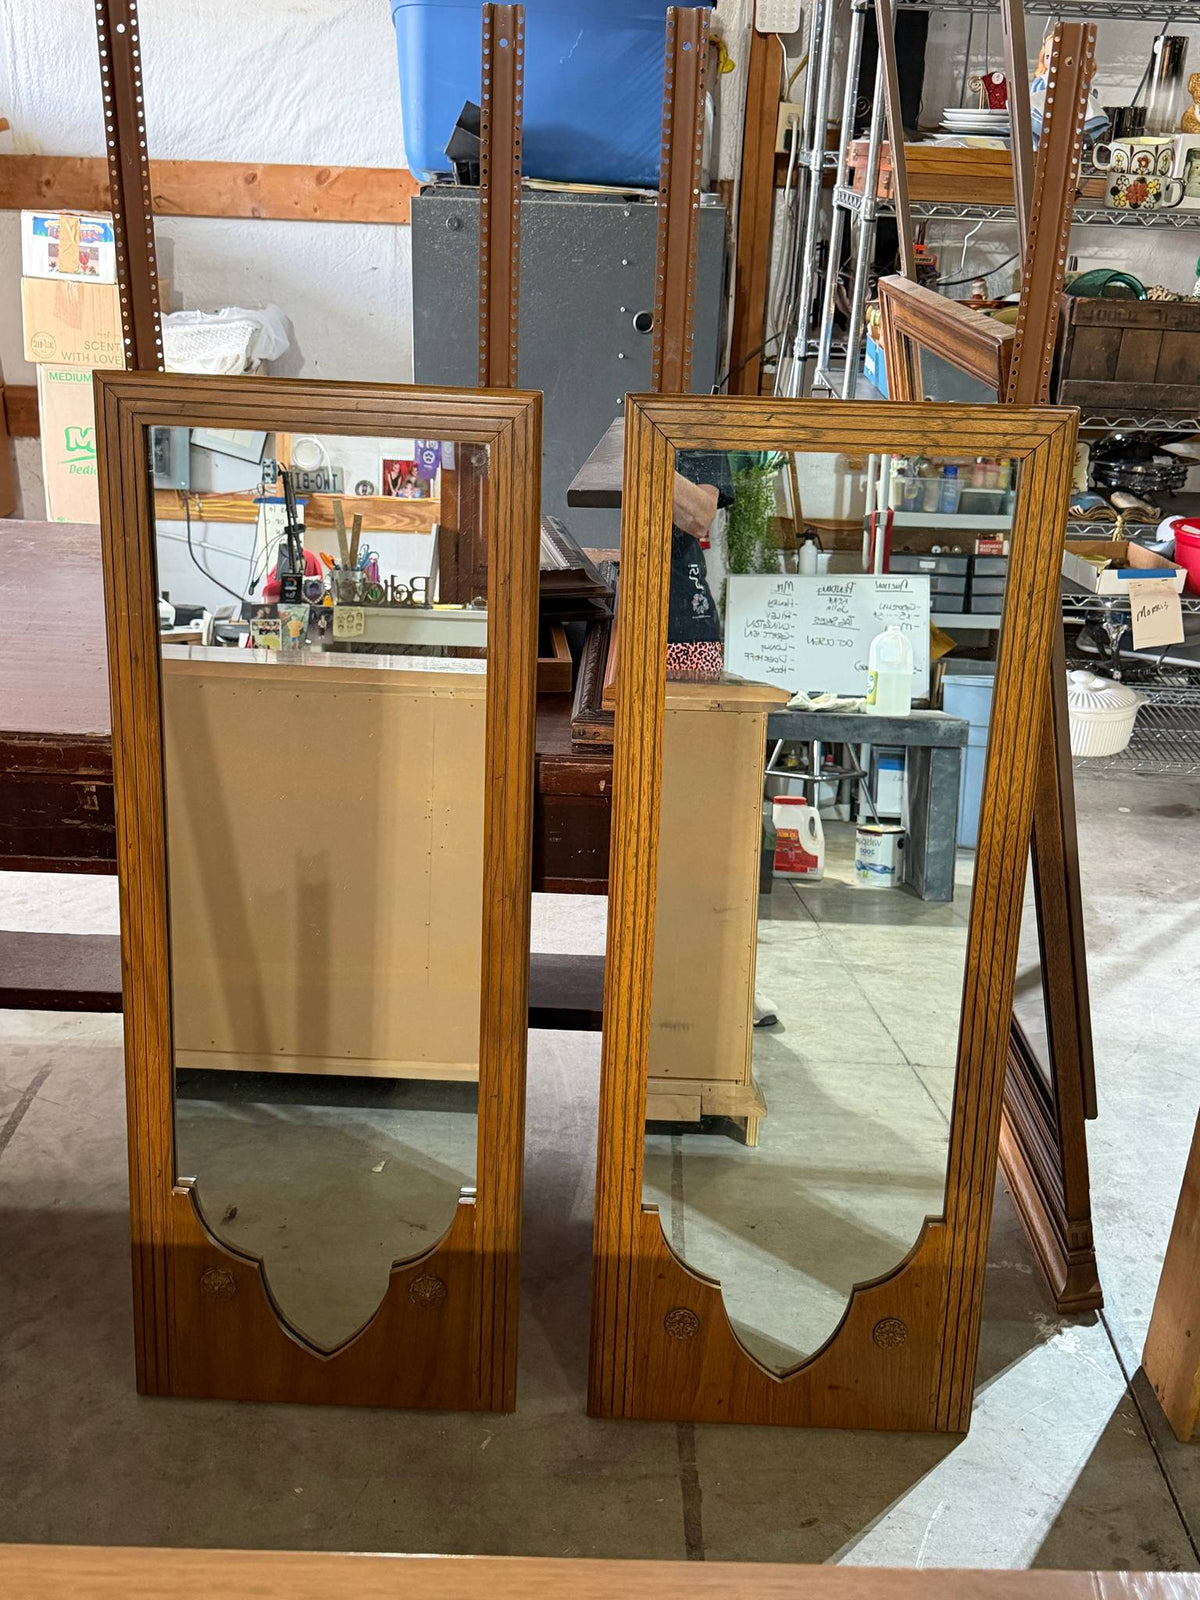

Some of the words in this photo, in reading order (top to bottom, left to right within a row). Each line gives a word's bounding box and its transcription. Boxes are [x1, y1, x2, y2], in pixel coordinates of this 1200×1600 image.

[84, 340, 121, 352] SCENT
[61, 352, 90, 362] WITH
[93, 353, 121, 365] LOVE
[49, 371, 92, 383] MEDIUM
